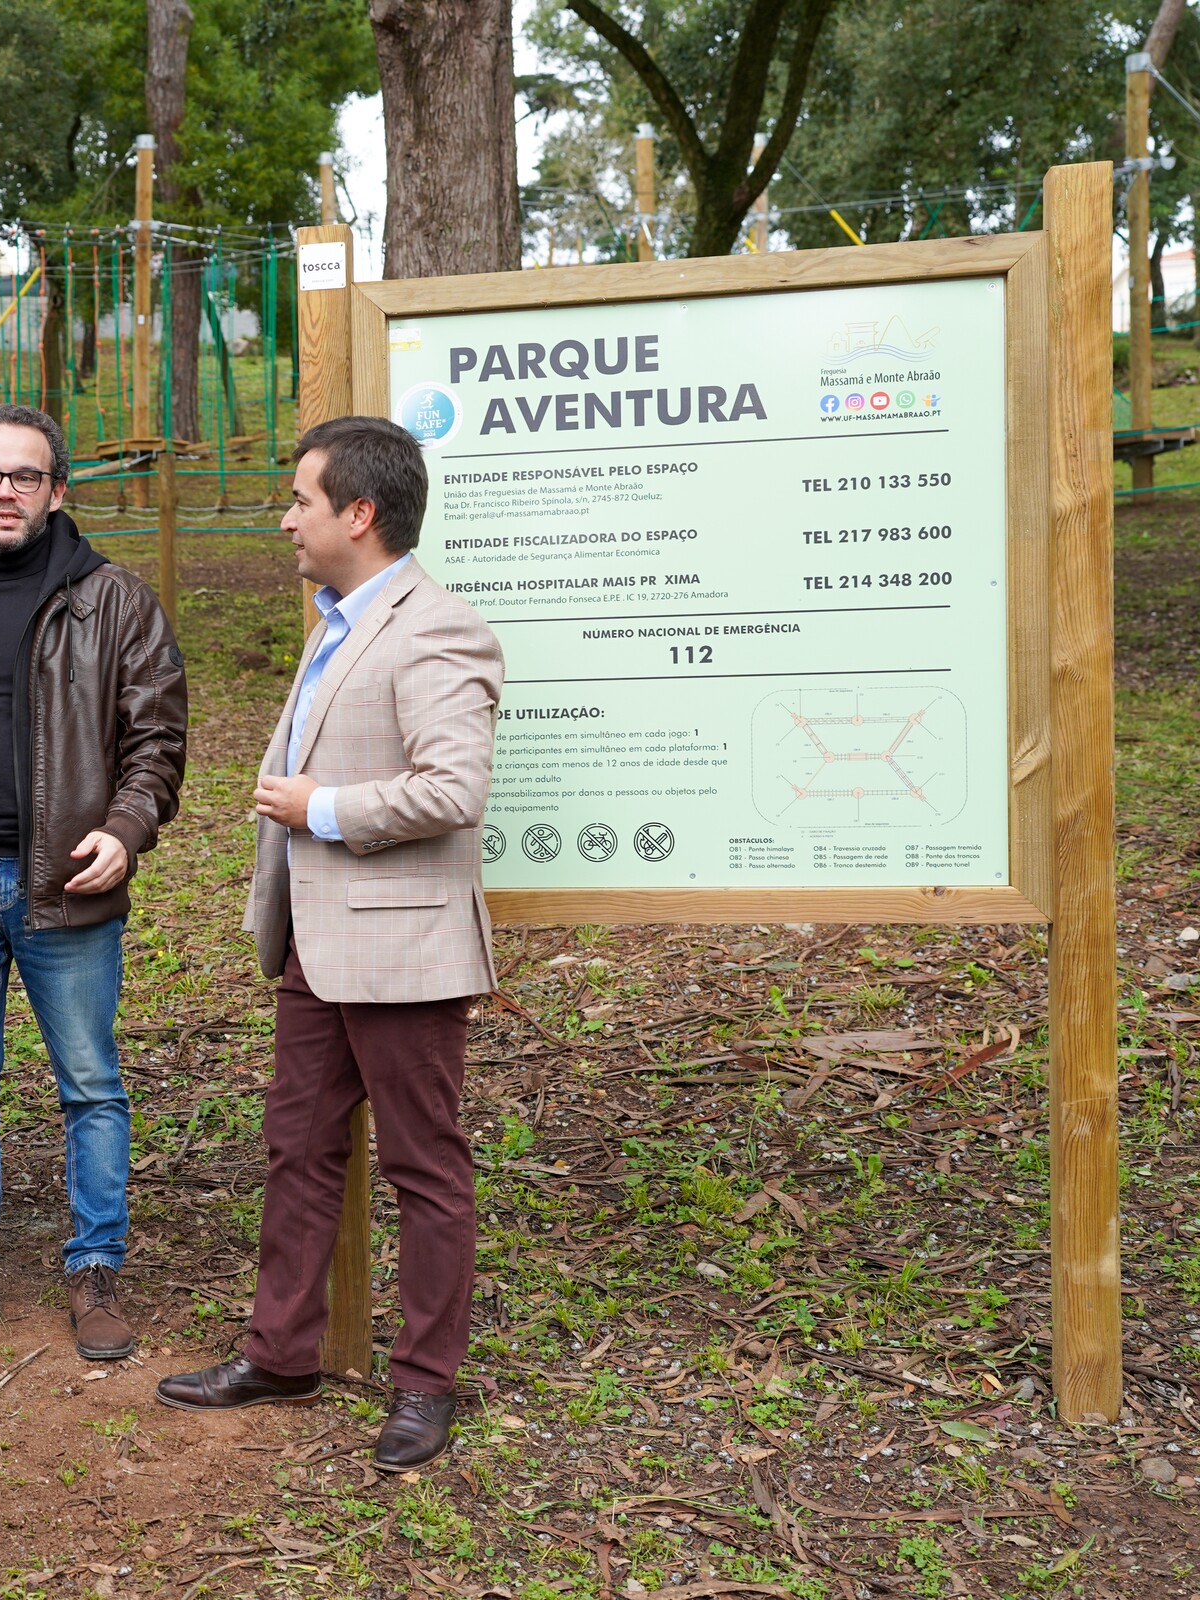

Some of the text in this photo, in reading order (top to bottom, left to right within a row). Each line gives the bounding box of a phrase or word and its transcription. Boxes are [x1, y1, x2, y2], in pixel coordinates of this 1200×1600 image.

[302, 262, 340, 273] toscca
[450, 334, 659, 384] PARQUE
[820, 370, 941, 387] Massamá e Monte Abraão
[821, 368, 847, 376] Freguesia
[417, 410, 440, 420] FUN
[479, 383, 768, 436] AVENTURA
[820, 410, 941, 422] WWW.UF-MASSAMAMABRAAO.PT
[444, 462, 698, 485] ENTIDADE RESPONSÁVEL PELO ESPAÇO
[443, 490, 468, 500] União
[468, 490, 483, 498] das
[484, 489, 526, 499] Freguesias
[527, 487, 538, 495] de
[539, 485, 577, 495] Massamá
[585, 484, 613, 492] Monte
[613, 482, 644, 491] Abraão
[802, 472, 952, 493] TEL 210 133 550
[443, 492, 663, 510] Rua Dr. Francisco Ribeiro Spínola, s/n, 2745-872 Queluz;
[443, 507, 590, 522] Email: geral@uf-massamamabraao.pt
[445, 529, 698, 550] ENTIDADE FISCALIZADORA DO ESPAÇO
[803, 525, 952, 545] TEL 217 983 600
[444, 547, 661, 565] ASAE Autoridade de Segurança Alimentar Económica
[446, 580, 513, 593] URGÊNCIA
[517, 578, 598, 591] HOSPITALAR
[602, 576, 636, 587] MAIS
[803, 571, 952, 590] TEL 214 348 200
[479, 598, 498, 607] Prof.
[498, 598, 528, 607] Doutor
[528, 595, 568, 605] Fernando
[568, 595, 602, 604] Fonseca
[626, 593, 635, 602] IC
[637, 592, 649, 602] 19,
[650, 591, 690, 601] 2720-276
[690, 590, 729, 599] Amadora
[583, 623, 801, 639] NÚMERO NACIONAL DE EMERGÊNCIA
[669, 645, 713, 664] 112
[516, 706, 605, 722] UTILIZAÇÃO:
[496, 733, 507, 741] de
[509, 732, 563, 743] participantes
[580, 730, 627, 740] simultâneo
[644, 729, 666, 738] cada
[668, 729, 691, 739] jogo:
[694, 728, 699, 737] 1
[504, 761, 540, 771] crianças
[562, 761, 590, 769] menos
[592, 759, 604, 768] de
[606, 758, 618, 768] 12
[619, 760, 641, 768] anos
[642, 758, 654, 767] de
[656, 758, 681, 767] idade
[683, 757, 709, 767] desde
[711, 759, 728, 767] que
